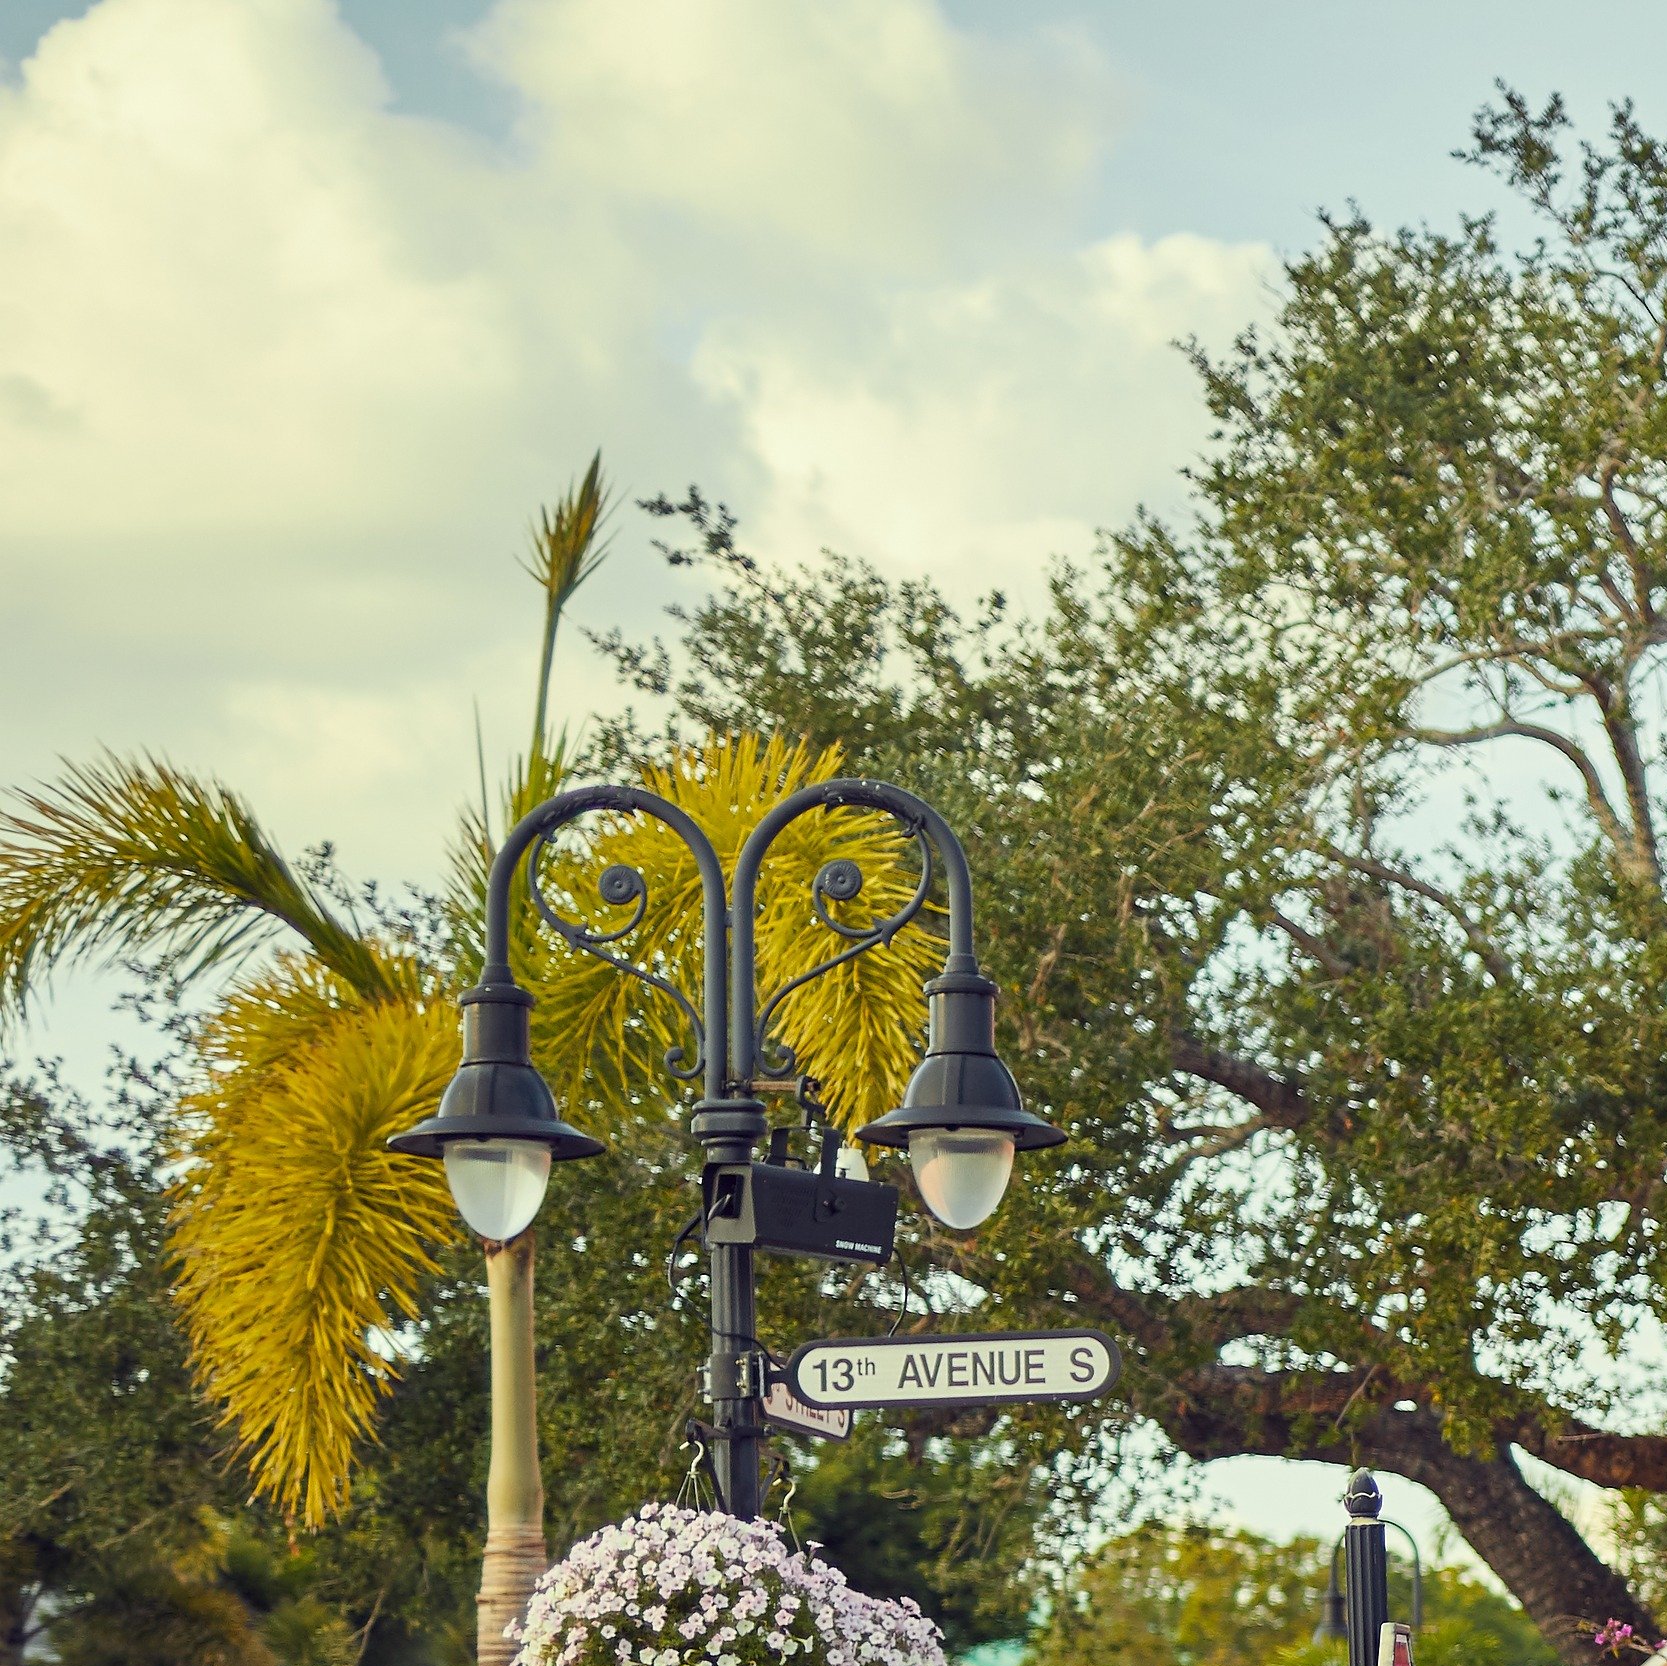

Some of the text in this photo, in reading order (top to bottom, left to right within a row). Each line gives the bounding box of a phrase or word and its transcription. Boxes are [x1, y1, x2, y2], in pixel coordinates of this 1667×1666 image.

[835, 1240, 882, 1255] SNOW MACHINE
[812, 1347, 1096, 1392] 13th AVENUE S
